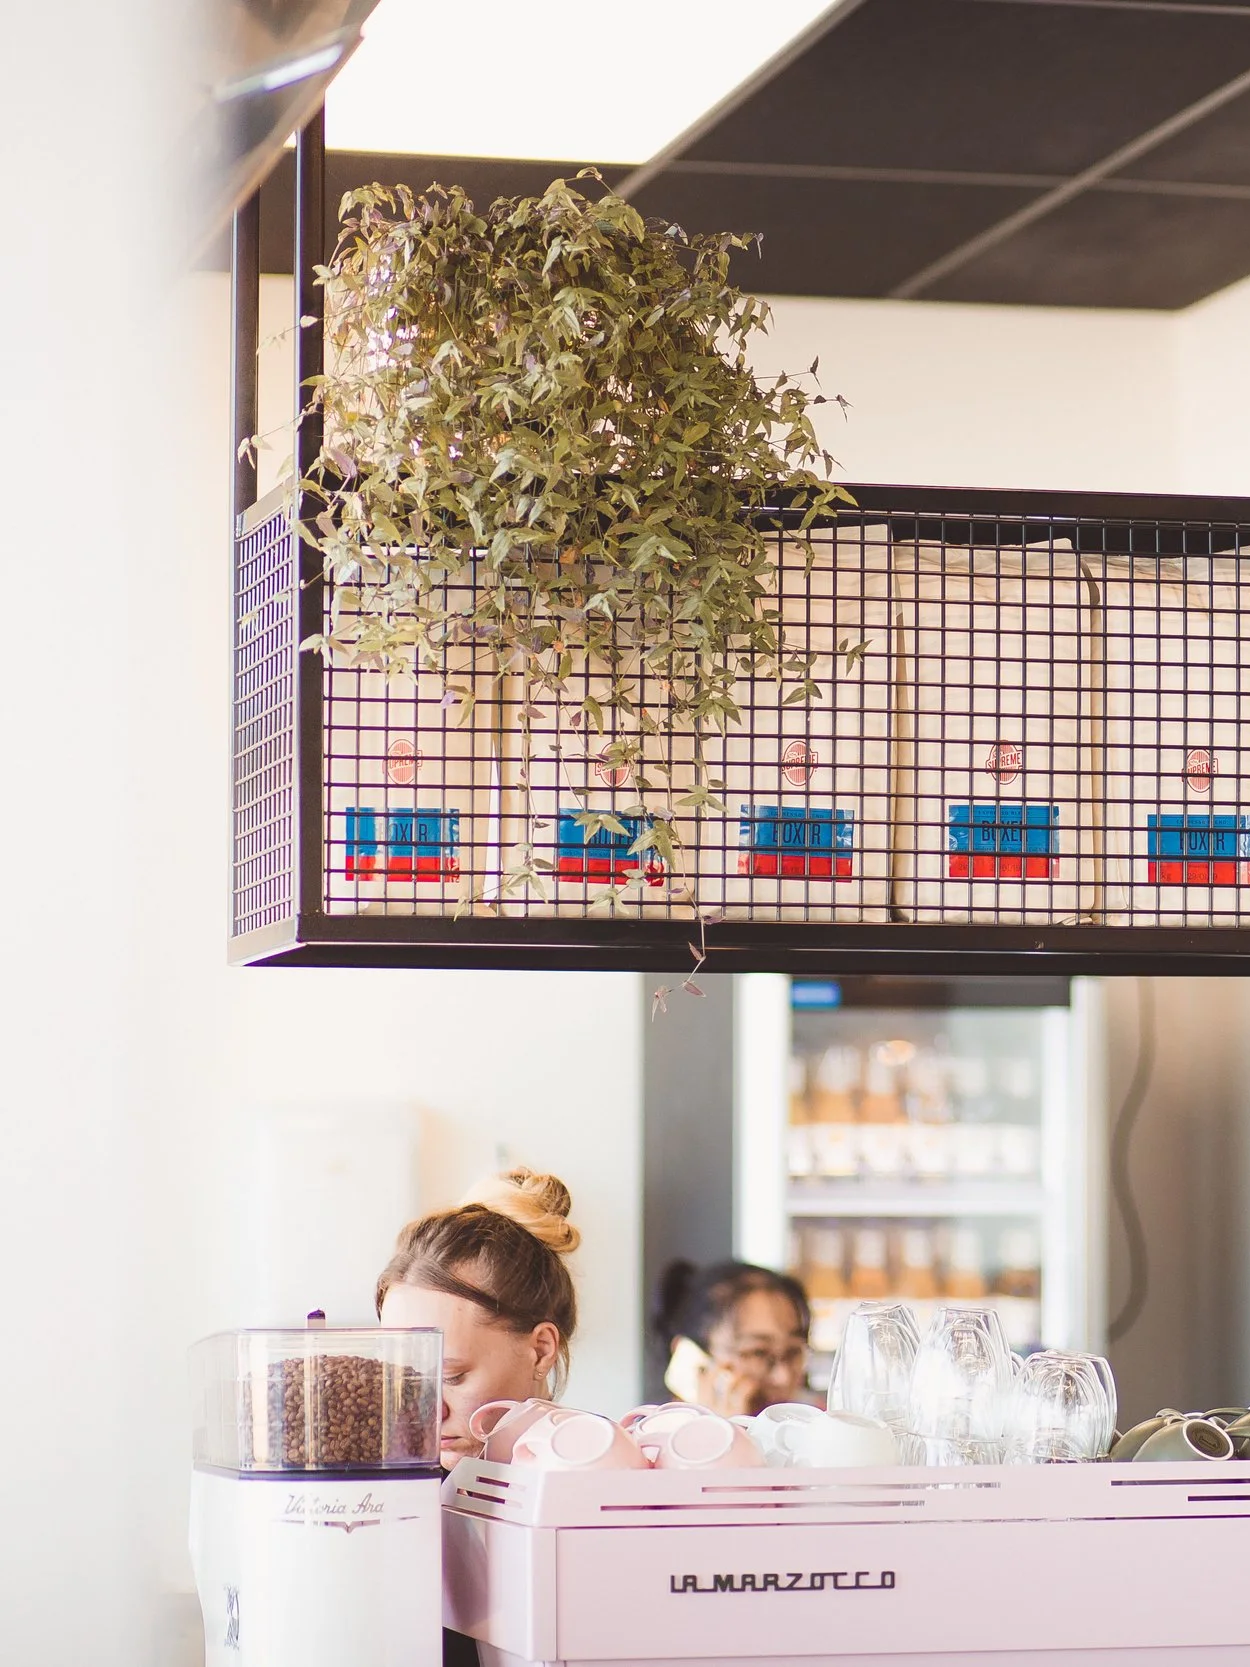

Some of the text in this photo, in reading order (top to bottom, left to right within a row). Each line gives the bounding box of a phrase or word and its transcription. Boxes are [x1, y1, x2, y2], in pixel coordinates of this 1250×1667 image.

[988, 752, 1021, 769] SUREME
[284, 1492, 347, 1515] Vitoria
[670, 1571, 896, 1593] LA MARZOCCO
